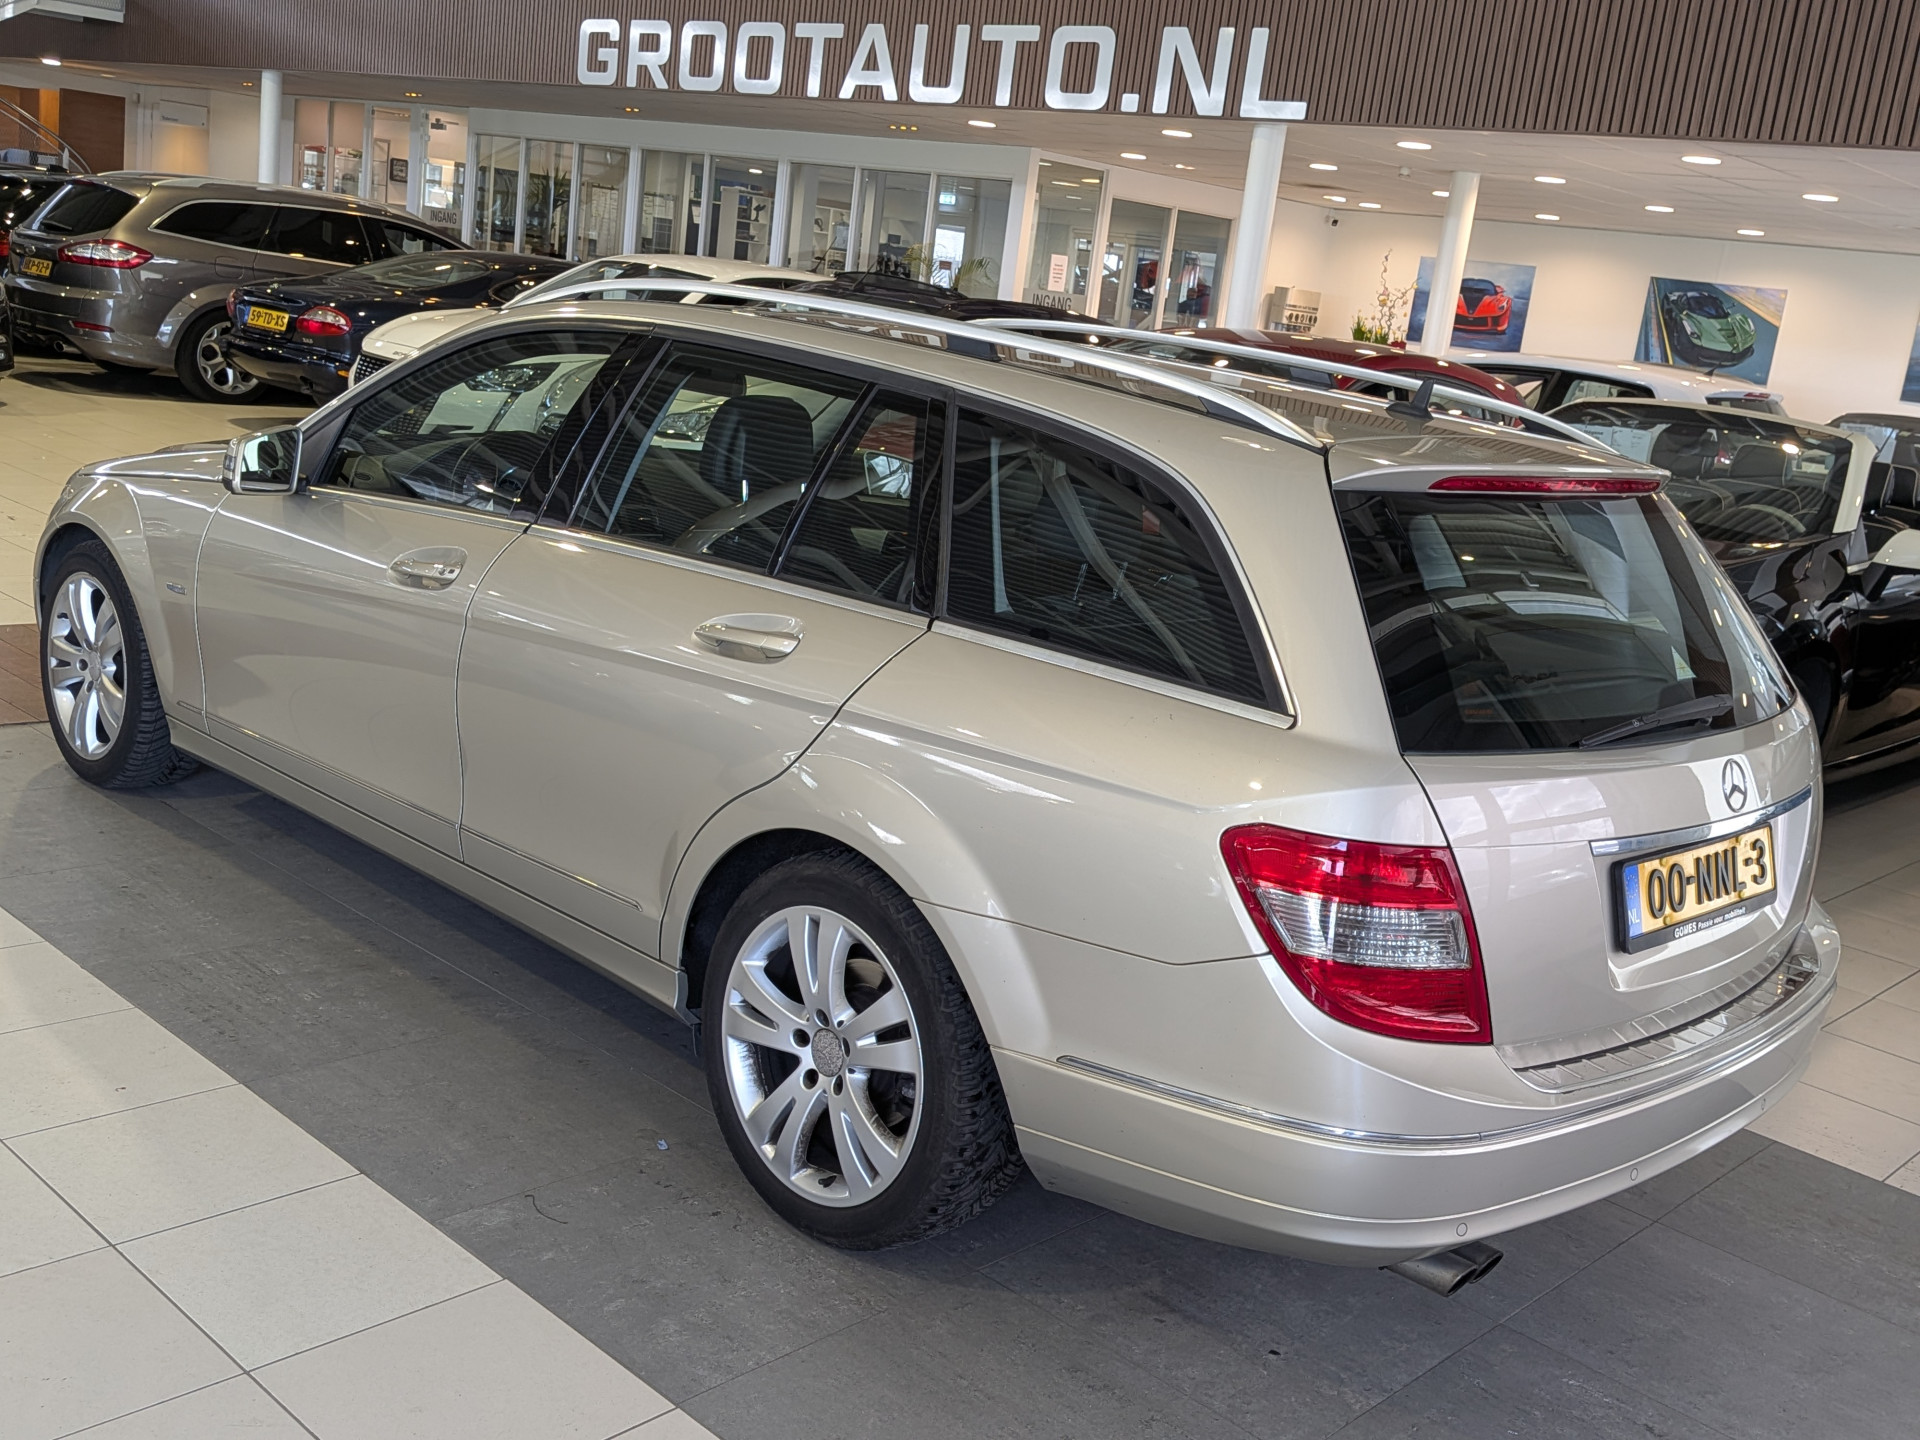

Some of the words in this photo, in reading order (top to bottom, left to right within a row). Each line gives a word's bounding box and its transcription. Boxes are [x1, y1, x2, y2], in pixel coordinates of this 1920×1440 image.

[577, 18, 1308, 120] GROOTAUTO.NL
[430, 210, 457, 225] INGANG
[1032, 293, 1072, 310] INGANG
[250, 309, 286, 328] 59-TD-XS
[1648, 838, 1768, 919] 00-NNL-3
[1628, 910, 1640, 926] NL
[1674, 921, 1697, 938] GOMES
